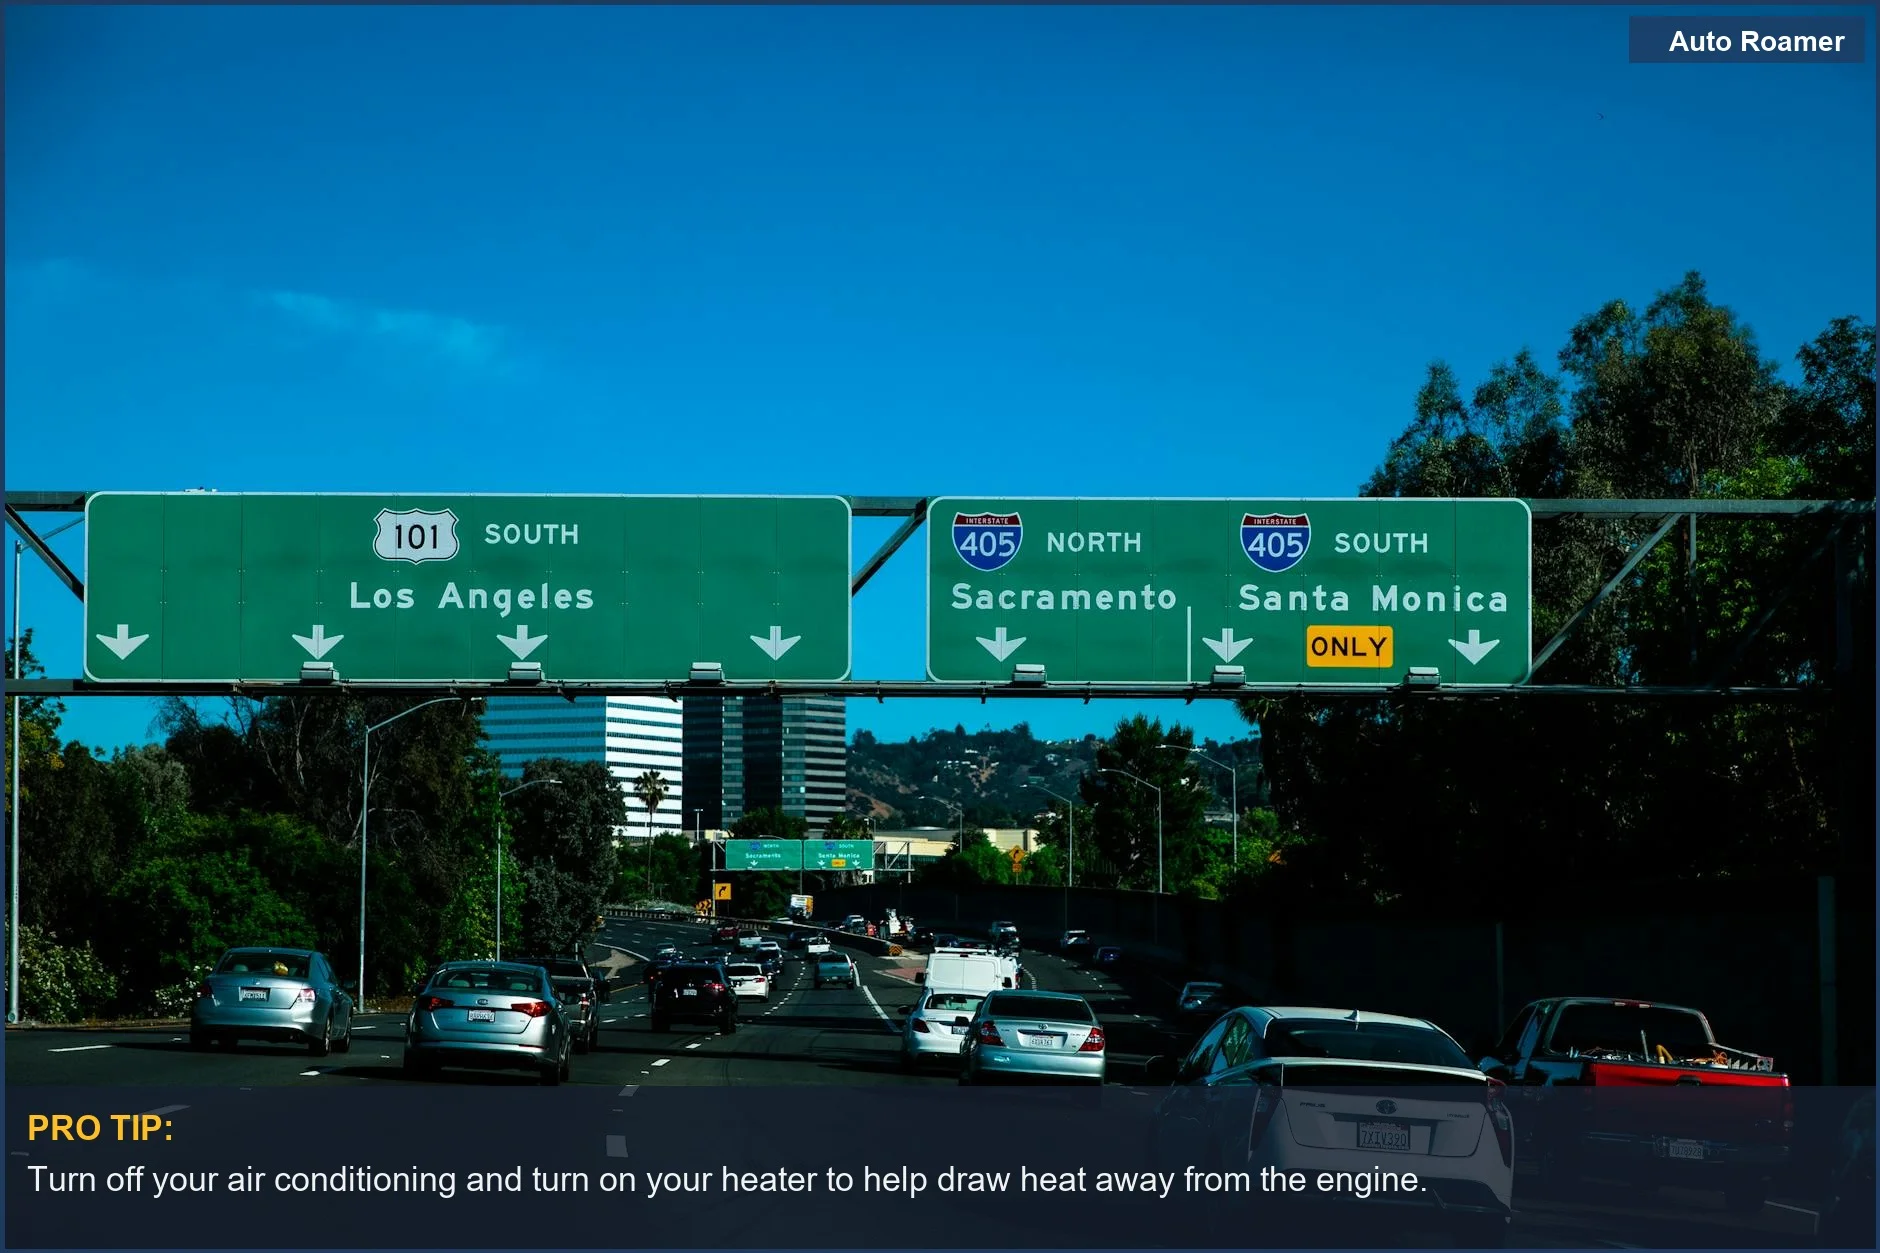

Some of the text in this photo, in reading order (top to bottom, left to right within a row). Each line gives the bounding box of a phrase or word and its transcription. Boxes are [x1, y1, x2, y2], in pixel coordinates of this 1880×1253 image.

[965, 516, 1009, 525] INTERSTATE
[1253, 517, 1297, 526] INTERSTATE
[395, 525, 441, 550] 101
[485, 523, 578, 545] SOUTH
[959, 531, 1015, 558] 405
[1047, 532, 1141, 553] NORTH
[1248, 532, 1304, 559] 405
[1334, 532, 1428, 553] SOUTH
[350, 581, 594, 618] Los Angeles
[951, 583, 1177, 611] Sacramento
[1239, 583, 1507, 613] Santa Monica
[1310, 635, 1388, 658] ONLY
[1361, 1130, 1407, 1146] 7XIV390
